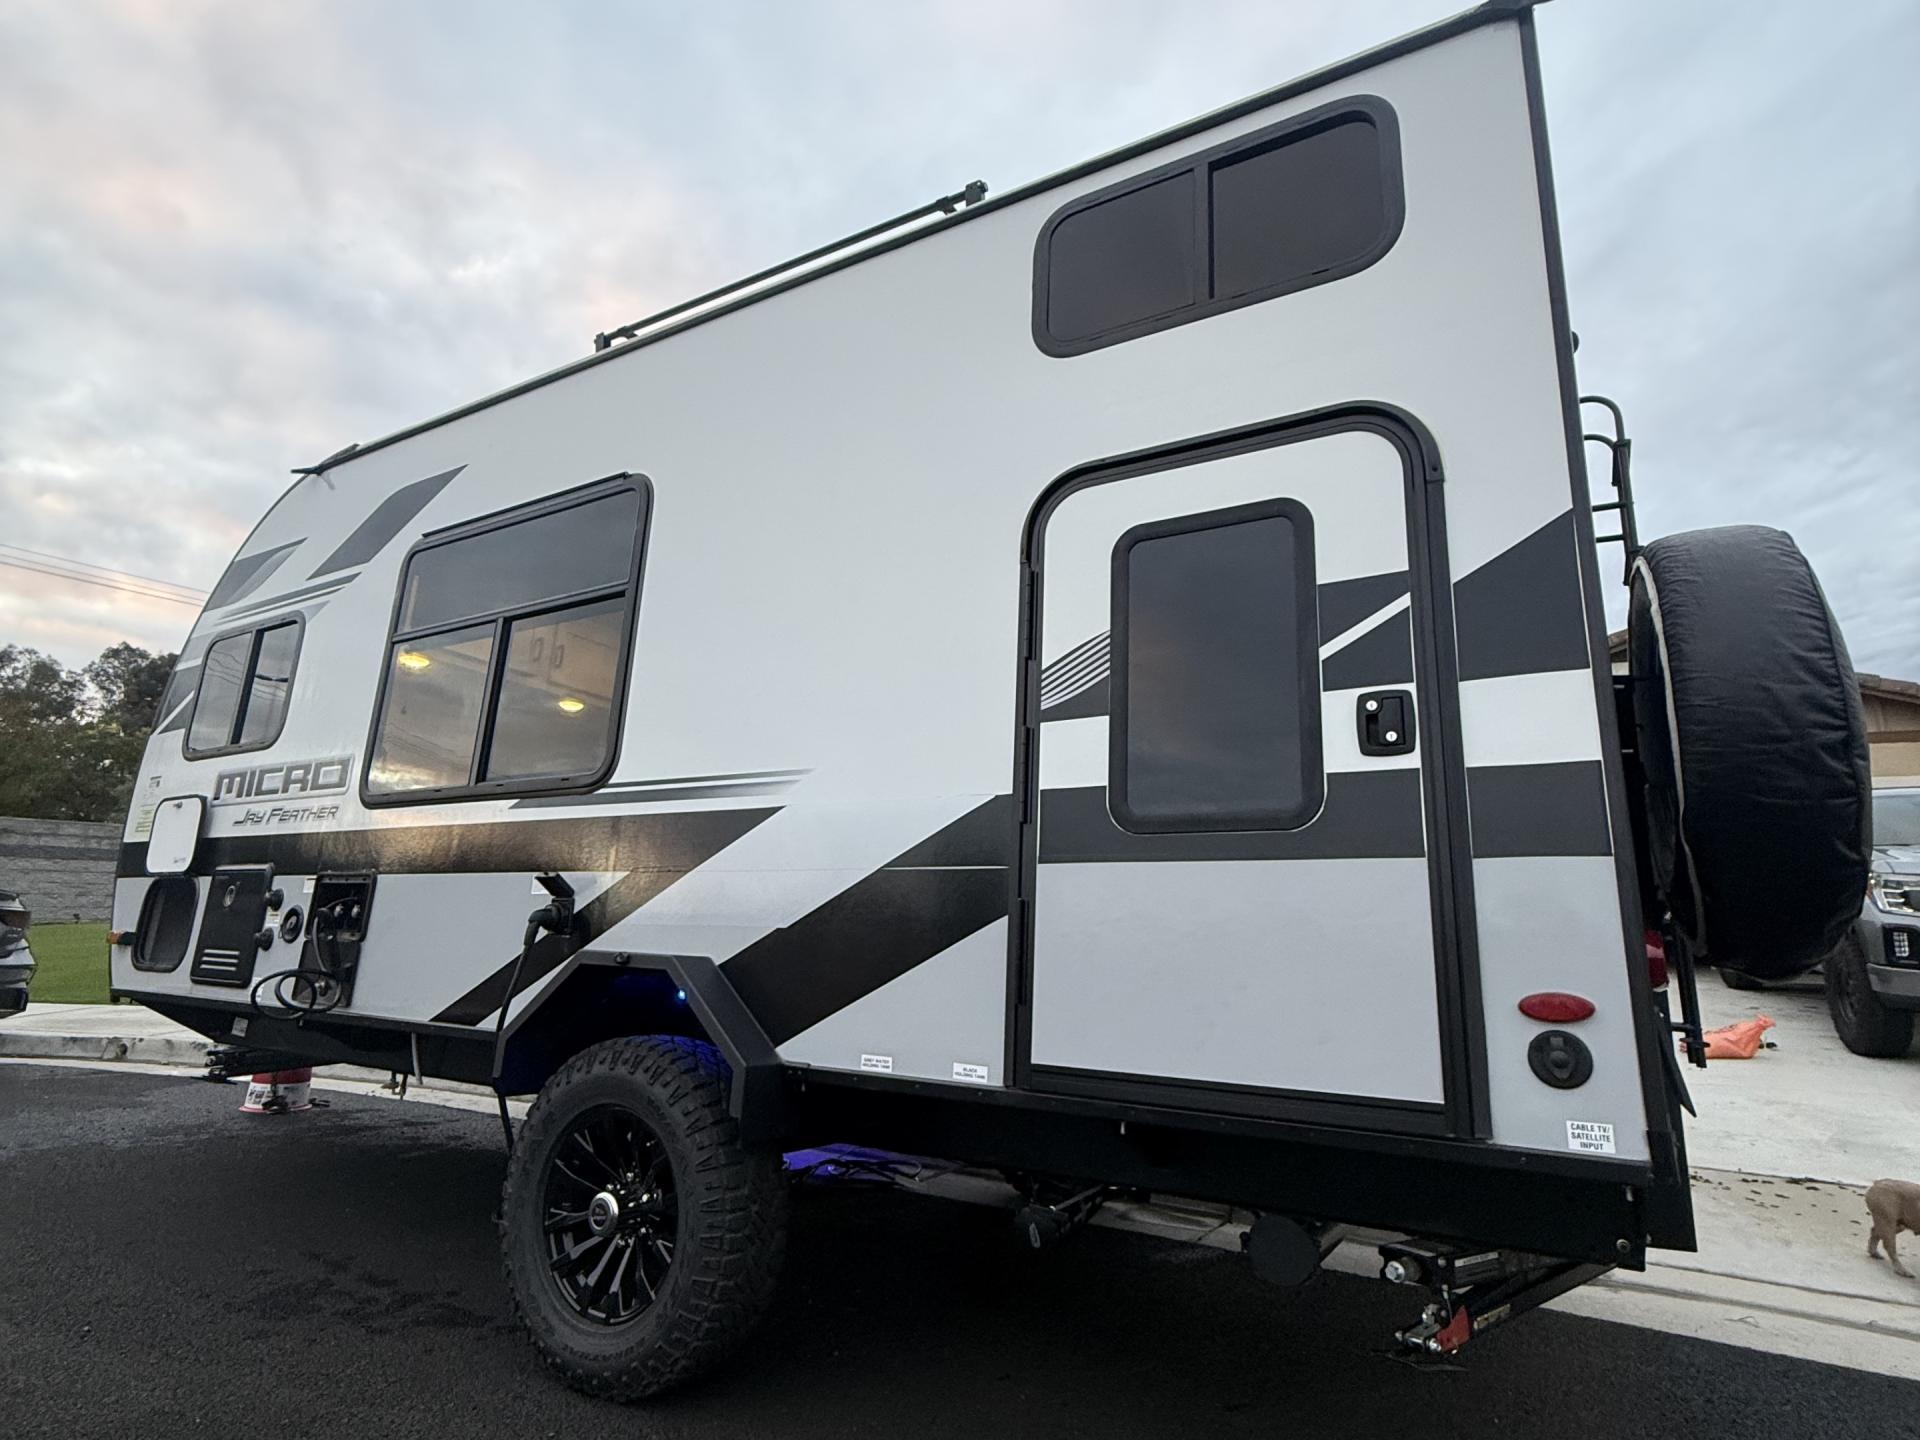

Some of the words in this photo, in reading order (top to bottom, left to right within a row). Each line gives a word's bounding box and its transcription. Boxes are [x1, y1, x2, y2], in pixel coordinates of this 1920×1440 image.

[213, 758, 351, 800] MICRO
[266, 806, 338, 824] FEATHER
[1570, 1122, 1595, 1132] CABLE
[1571, 1132, 1610, 1142] SATELLITE
[1580, 1141, 1604, 1150] INPUT
